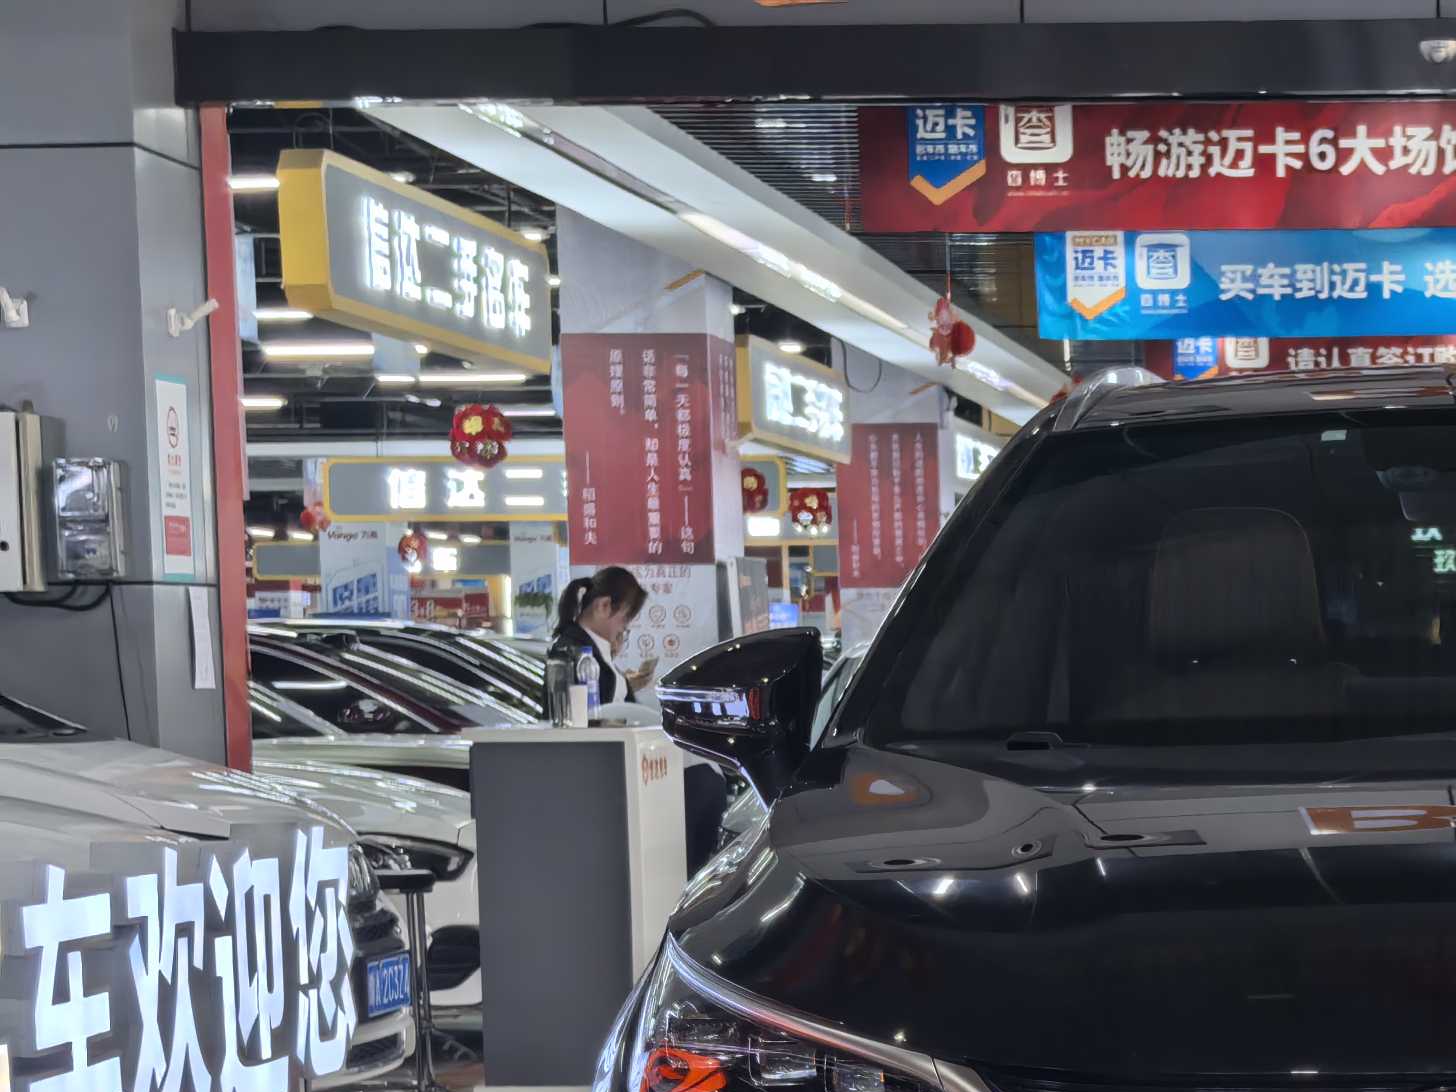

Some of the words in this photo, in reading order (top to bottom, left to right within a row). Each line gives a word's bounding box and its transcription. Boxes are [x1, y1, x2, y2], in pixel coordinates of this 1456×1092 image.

[915, 108, 977, 139] 迈卡
[1073, 249, 1118, 271] 迈卡
[1219, 262, 1405, 301] 买车到迈卡
